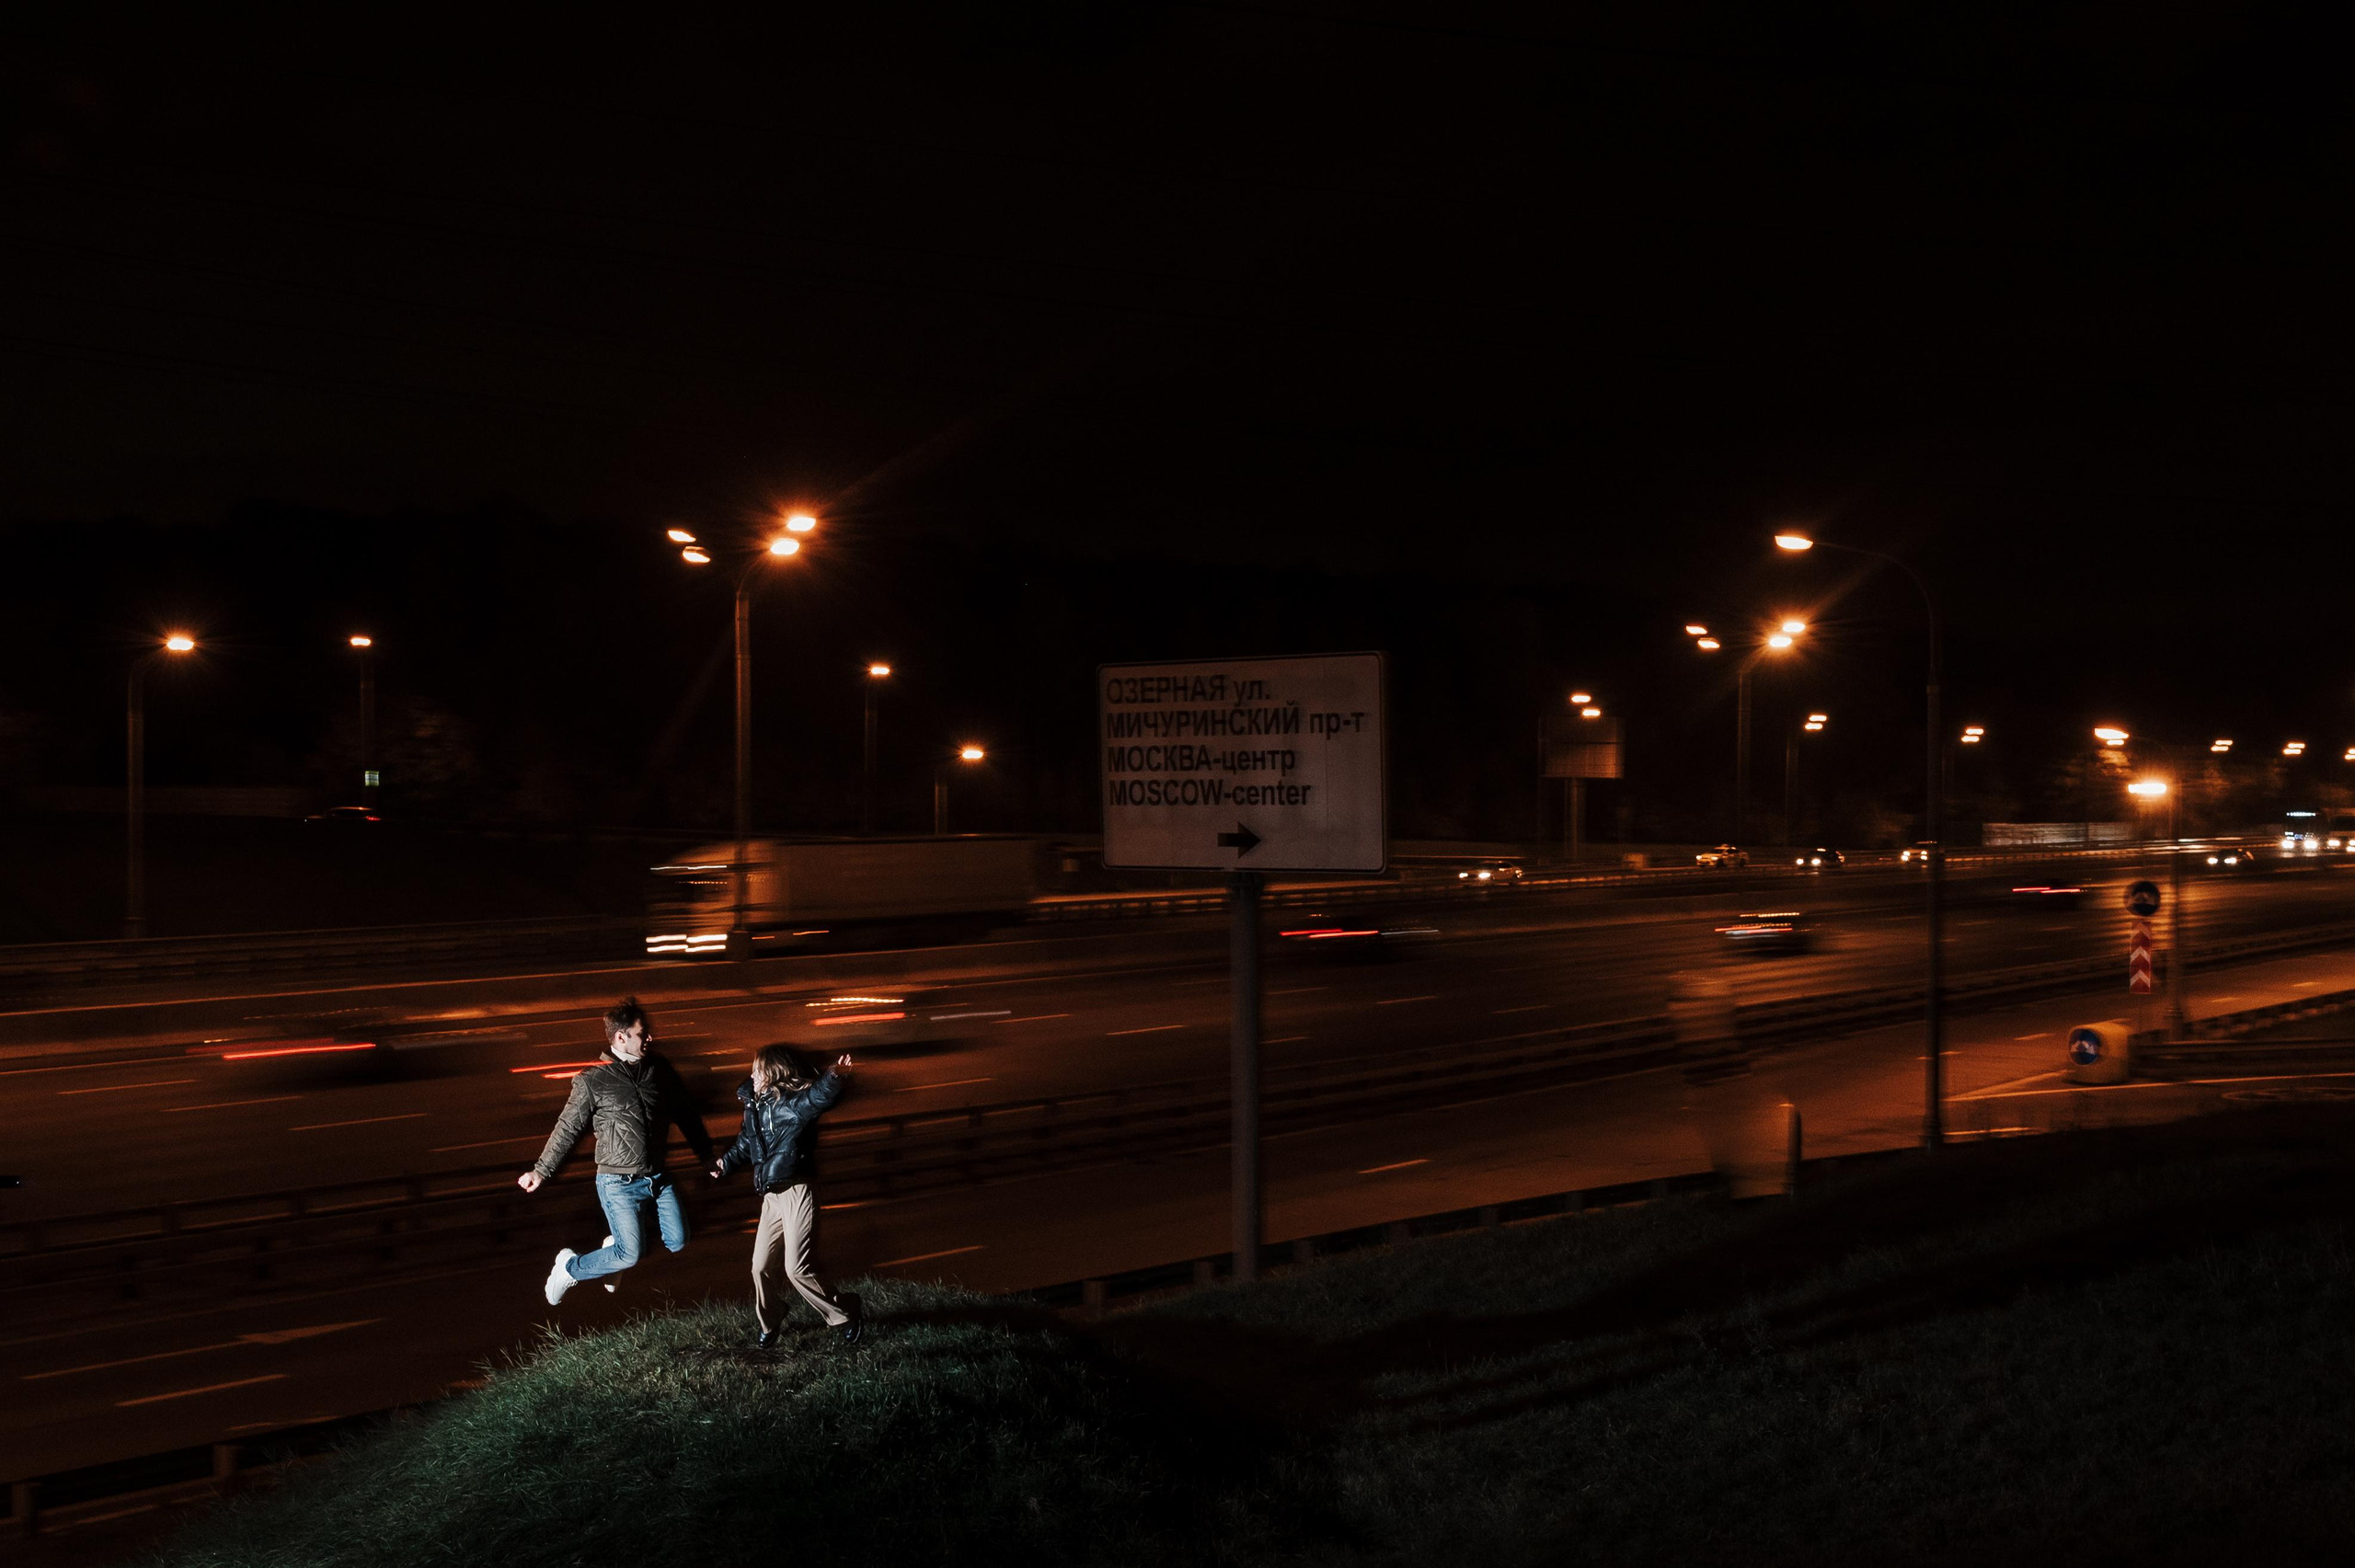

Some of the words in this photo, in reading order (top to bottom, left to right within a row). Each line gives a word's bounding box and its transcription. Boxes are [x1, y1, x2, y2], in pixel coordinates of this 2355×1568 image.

[1106, 674, 1225, 704] ОЗЕРНАЯ
[1234, 680, 1270, 708] ул.
[1107, 700, 1300, 738] МИЧУРИНСКИЙ
[1309, 712, 1365, 739] пр-т
[1108, 744, 1296, 776] МОСКВА-центр
[1109, 779, 1311, 807] MOSCOW-center
